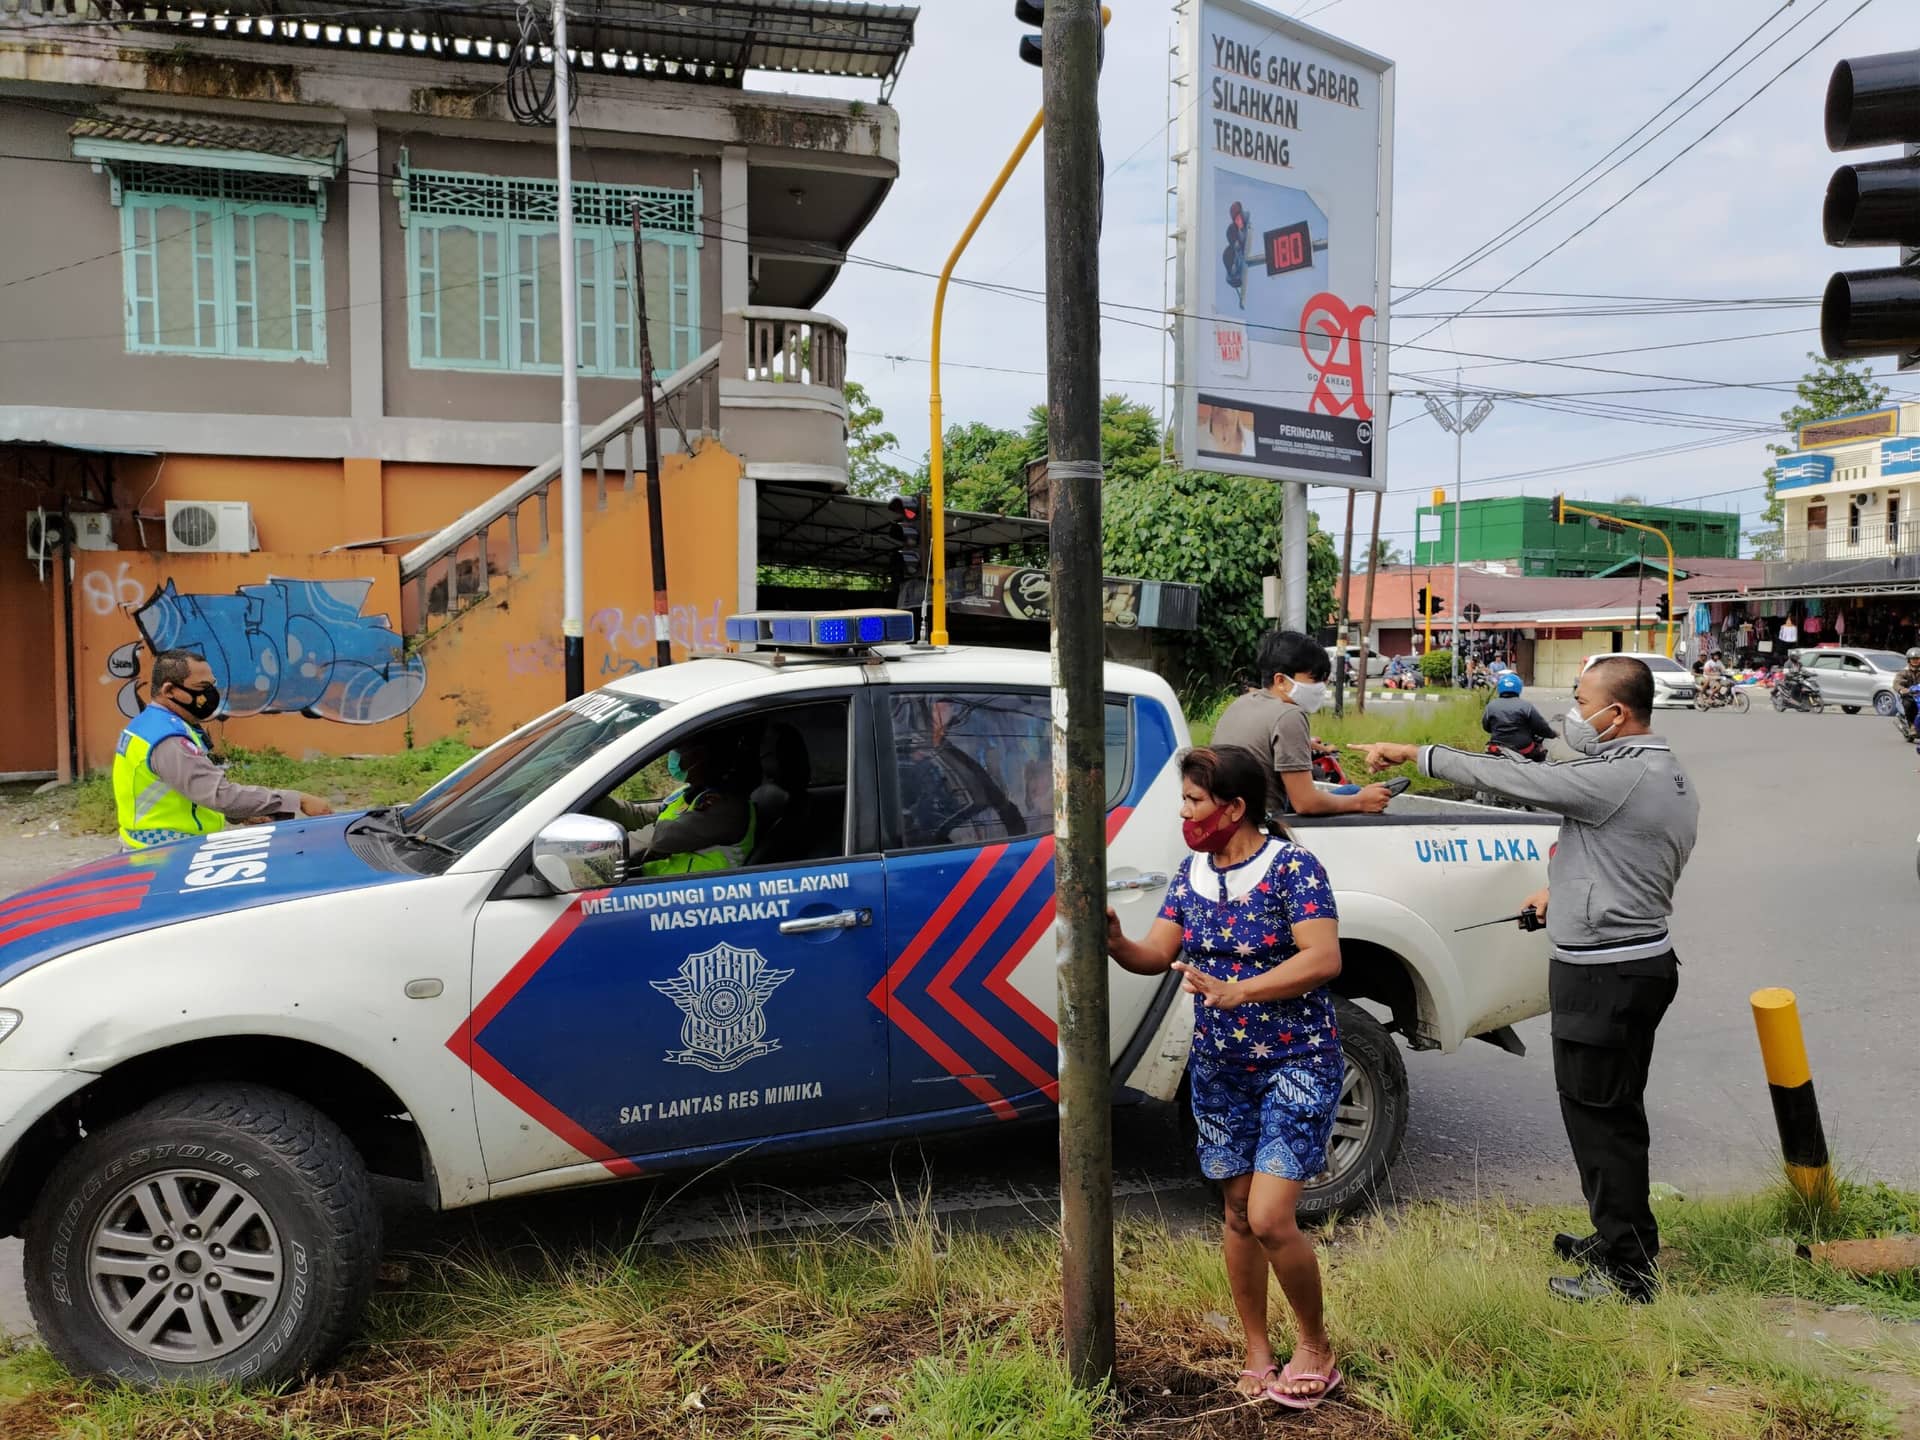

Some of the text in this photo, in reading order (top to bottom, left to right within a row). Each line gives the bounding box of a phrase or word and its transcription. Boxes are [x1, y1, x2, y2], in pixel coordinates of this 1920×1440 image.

[1212, 33, 1360, 107] YANG GAK SABAR
[1212, 76, 1298, 129] SILAHKAN
[1213, 118, 1290, 167] TERBANG
[1307, 373, 1351, 388] GO AHEAD
[1280, 424, 1335, 442] PERINGATAN:
[179, 825, 277, 894] POLISI
[1415, 839, 1540, 862] UNIT LAKA
[580, 872, 849, 916] MELINDUNGI DAN MELAYANI
[650, 900, 790, 931] MASYARAKAT
[620, 1081, 823, 1125] SAT LANTAS RES MIMIKA
[51, 1143, 261, 1306] BRIDGESTONE
